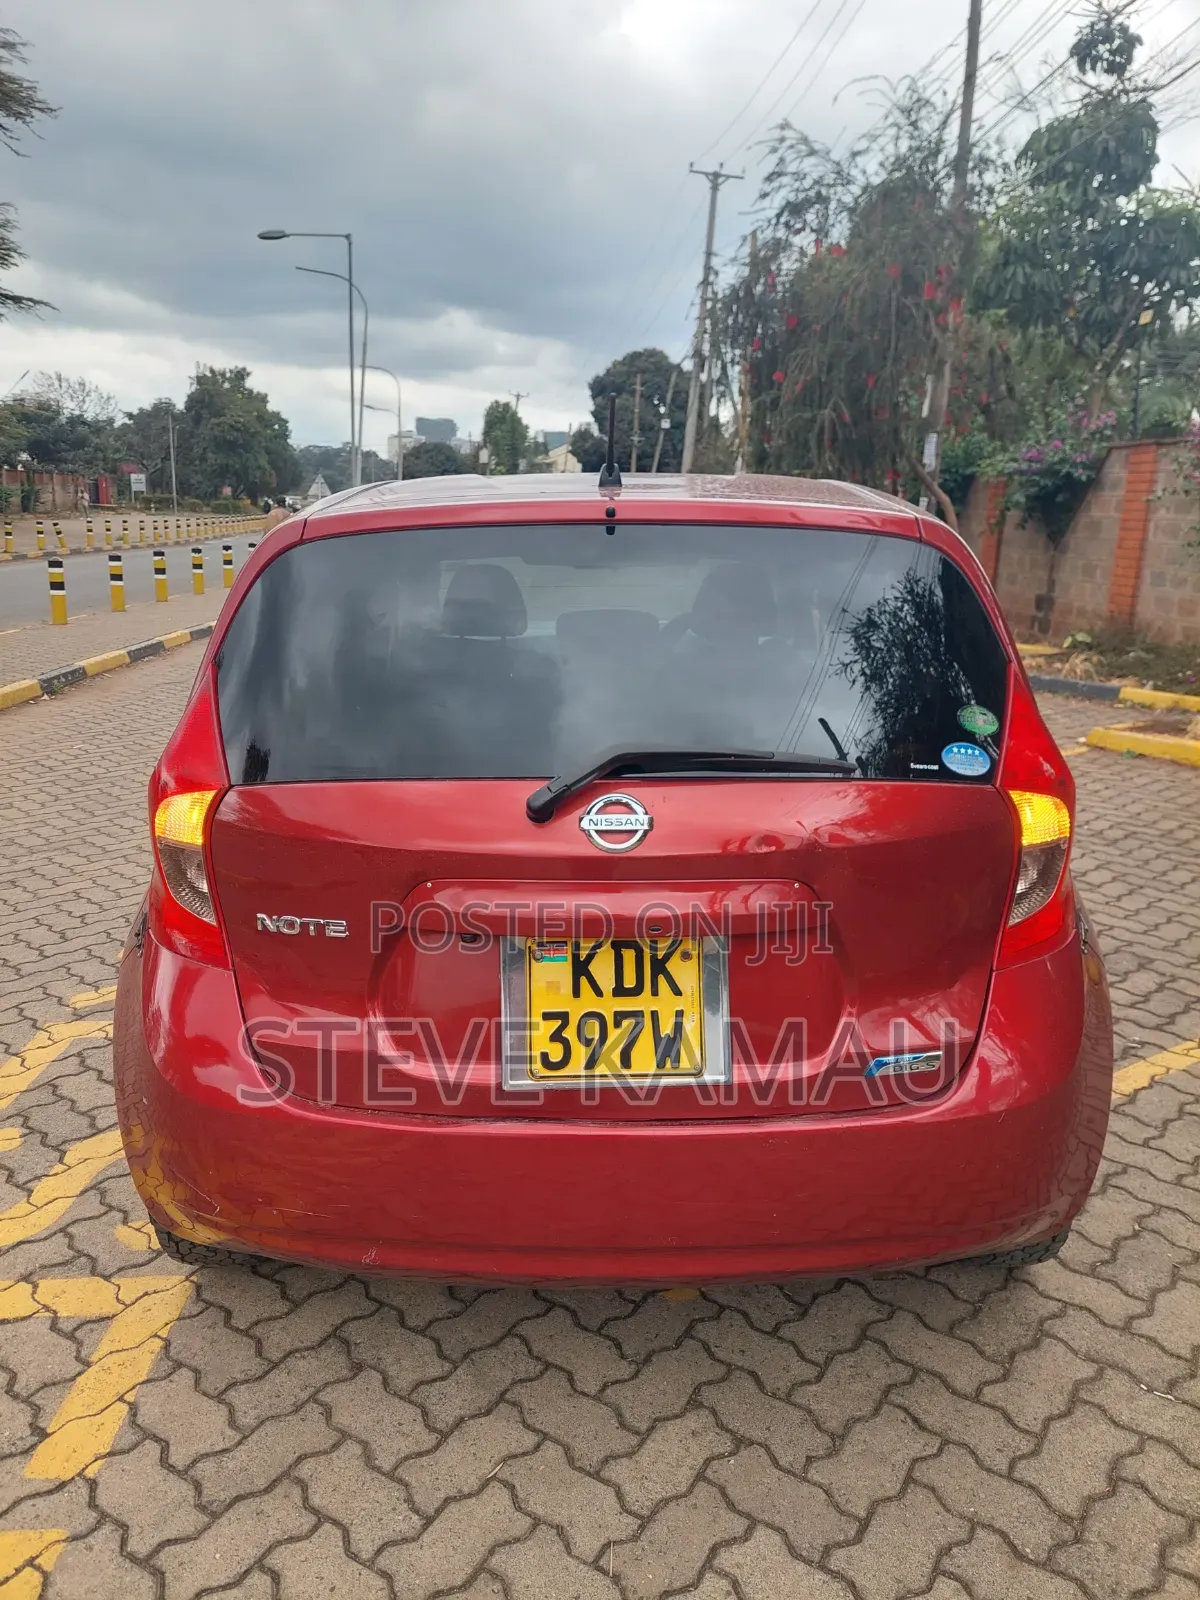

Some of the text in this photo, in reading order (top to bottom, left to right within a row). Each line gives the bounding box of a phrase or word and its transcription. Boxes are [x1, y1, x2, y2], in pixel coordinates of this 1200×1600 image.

[588, 818, 645, 827] NISSAN
[256, 913, 349, 938] NOTE
[571, 939, 683, 998] KDK
[540, 1009, 684, 1071] 397W
